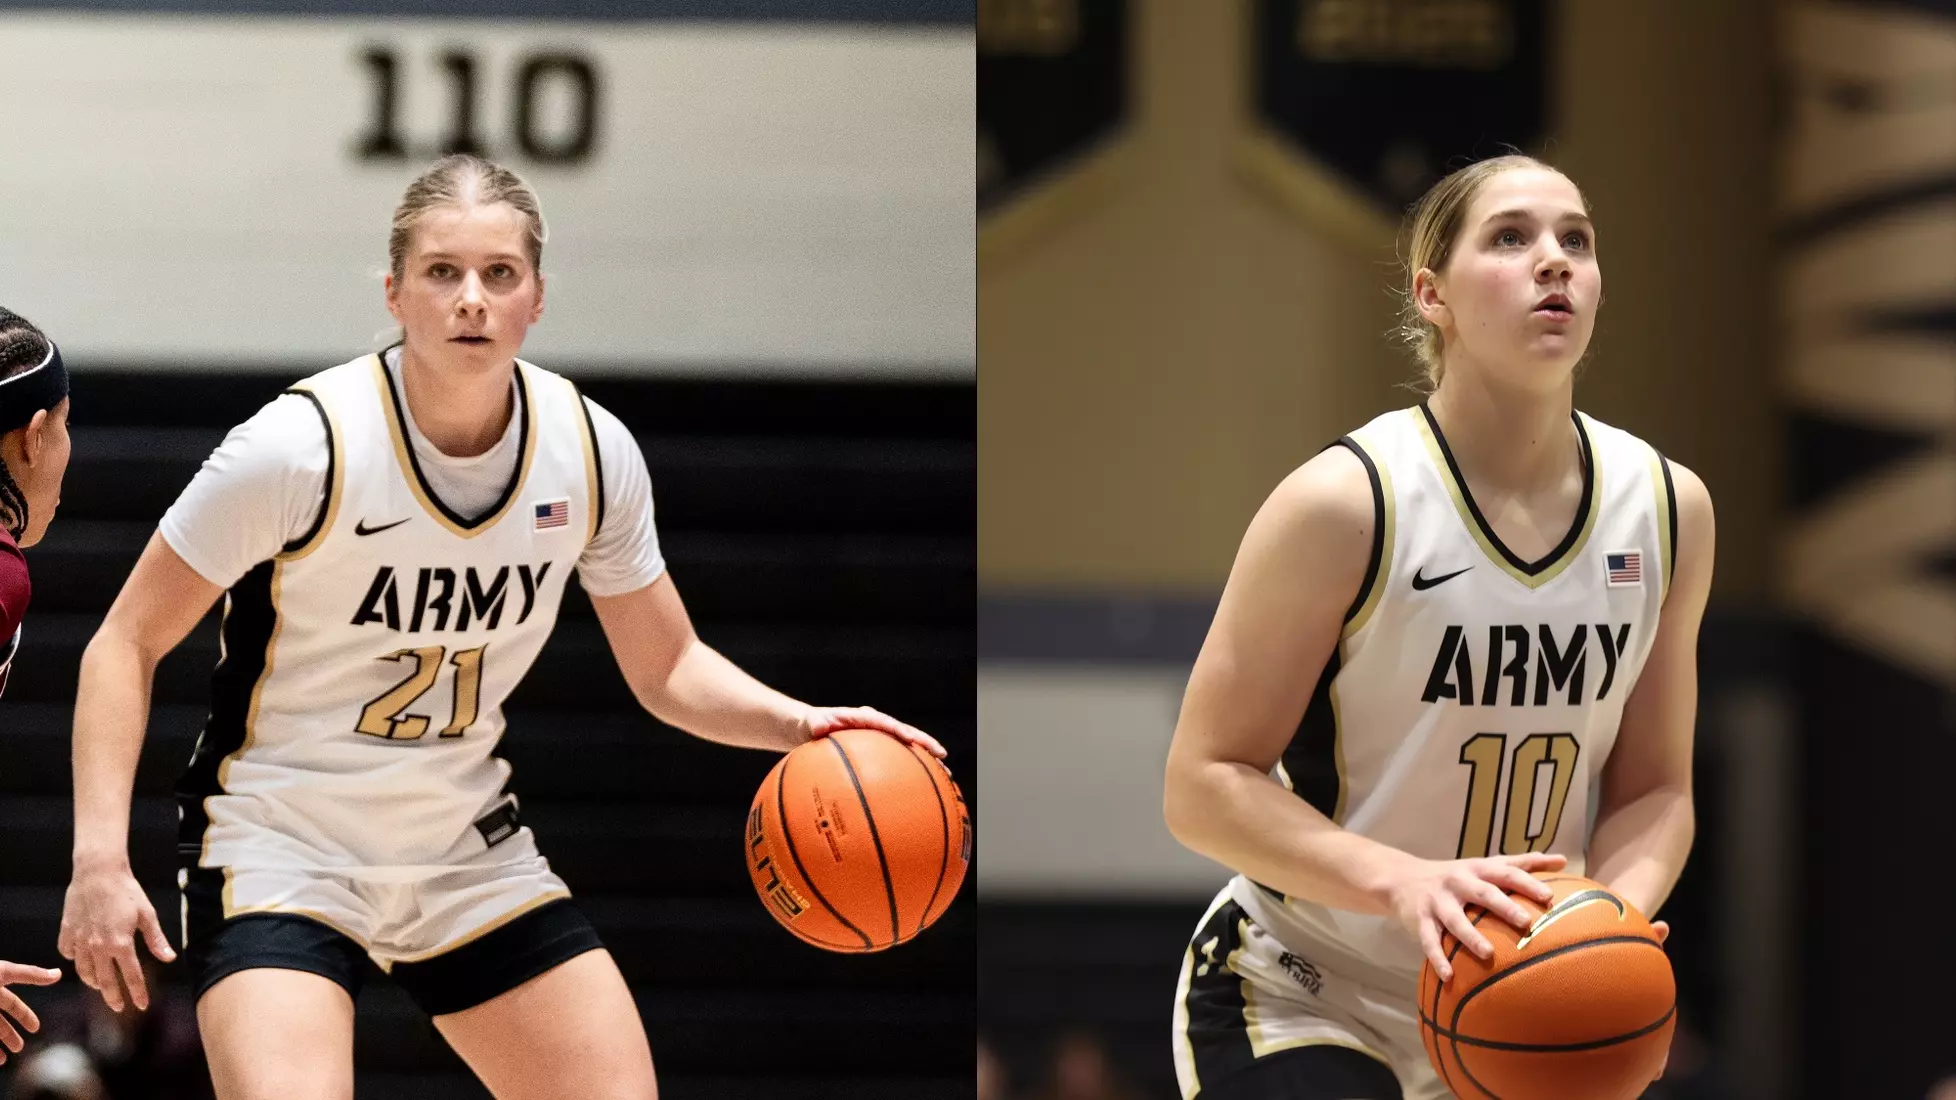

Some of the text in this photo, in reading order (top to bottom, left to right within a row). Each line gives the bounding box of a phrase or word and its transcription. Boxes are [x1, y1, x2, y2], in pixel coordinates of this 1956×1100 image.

[347, 48, 604, 160] 110
[350, 561, 553, 633] ARMY
[354, 643, 489, 740] 21
[1420, 623, 1631, 706] ARMY
[1456, 732, 1580, 859] 10
[749, 801, 803, 919] ELITE
